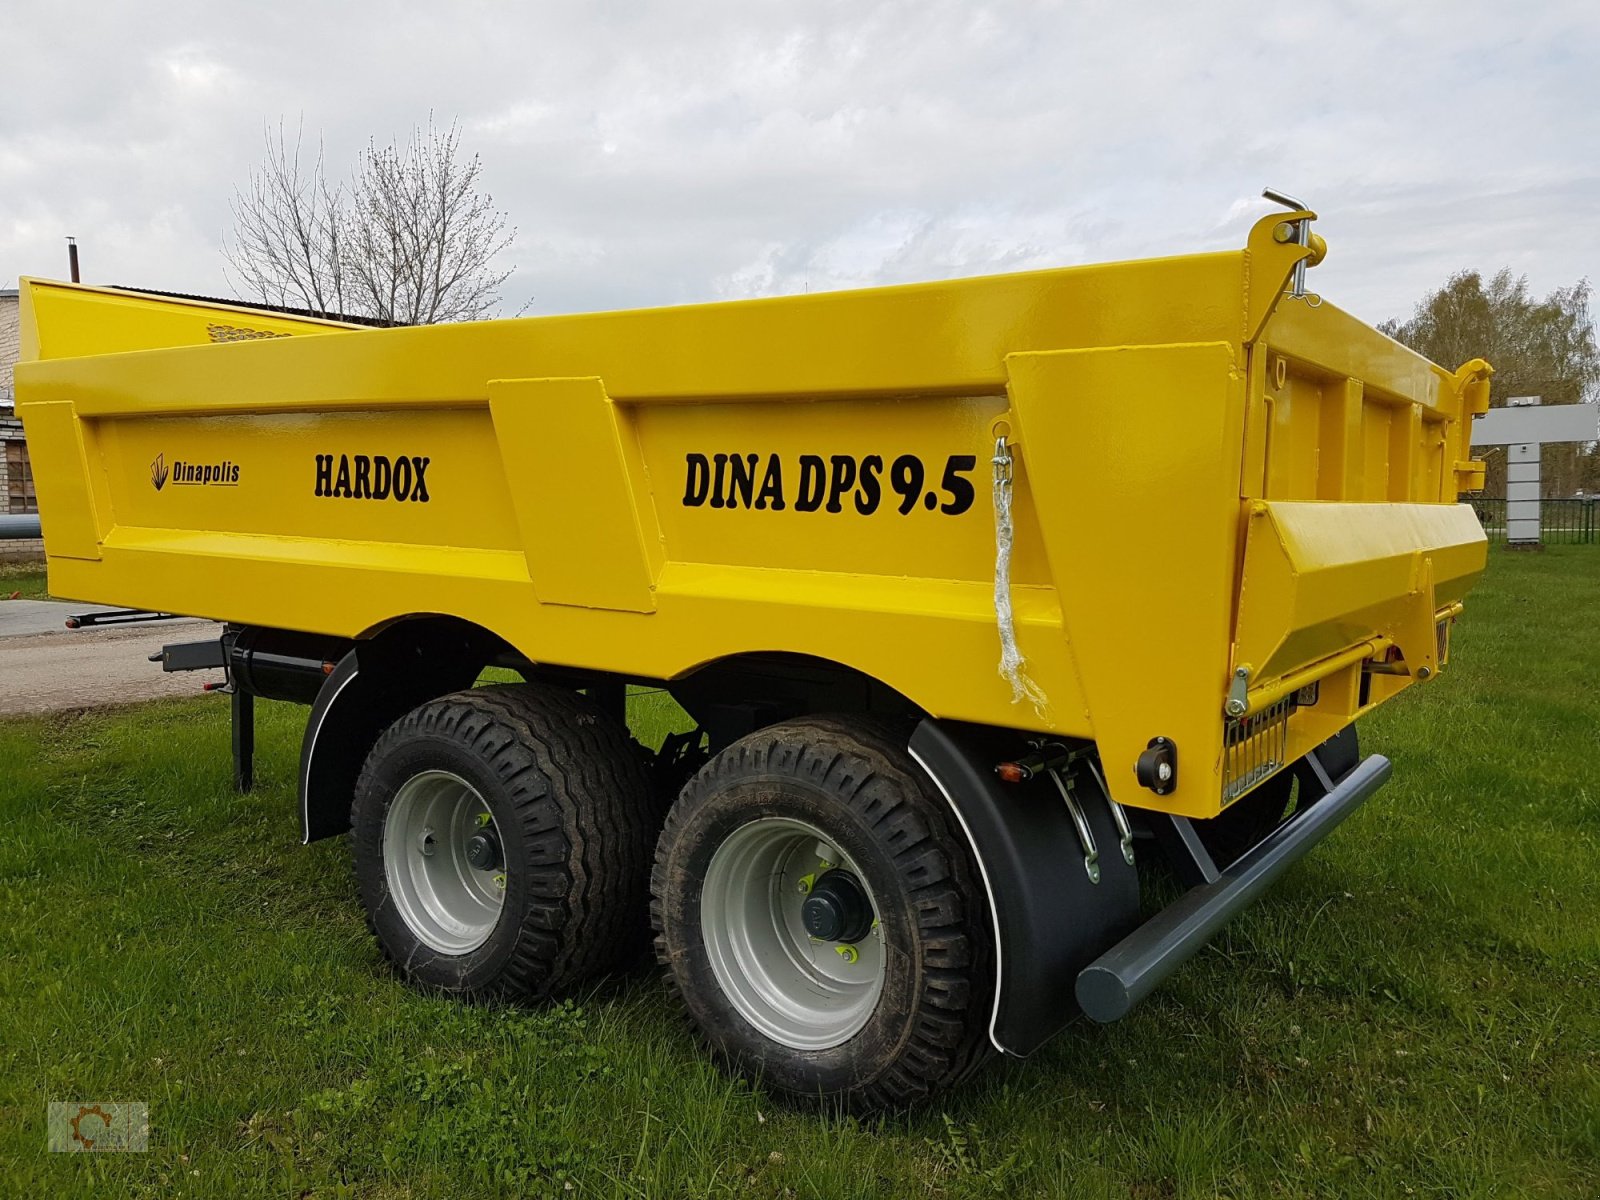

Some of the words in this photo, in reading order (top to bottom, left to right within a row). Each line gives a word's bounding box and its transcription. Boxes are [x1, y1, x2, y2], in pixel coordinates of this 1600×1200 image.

[173, 461, 240, 485] Dinapolis
[314, 453, 431, 503] HARDOX
[682, 453, 786, 511] DINA
[794, 454, 884, 516] DPS
[890, 454, 977, 516] 9.5
